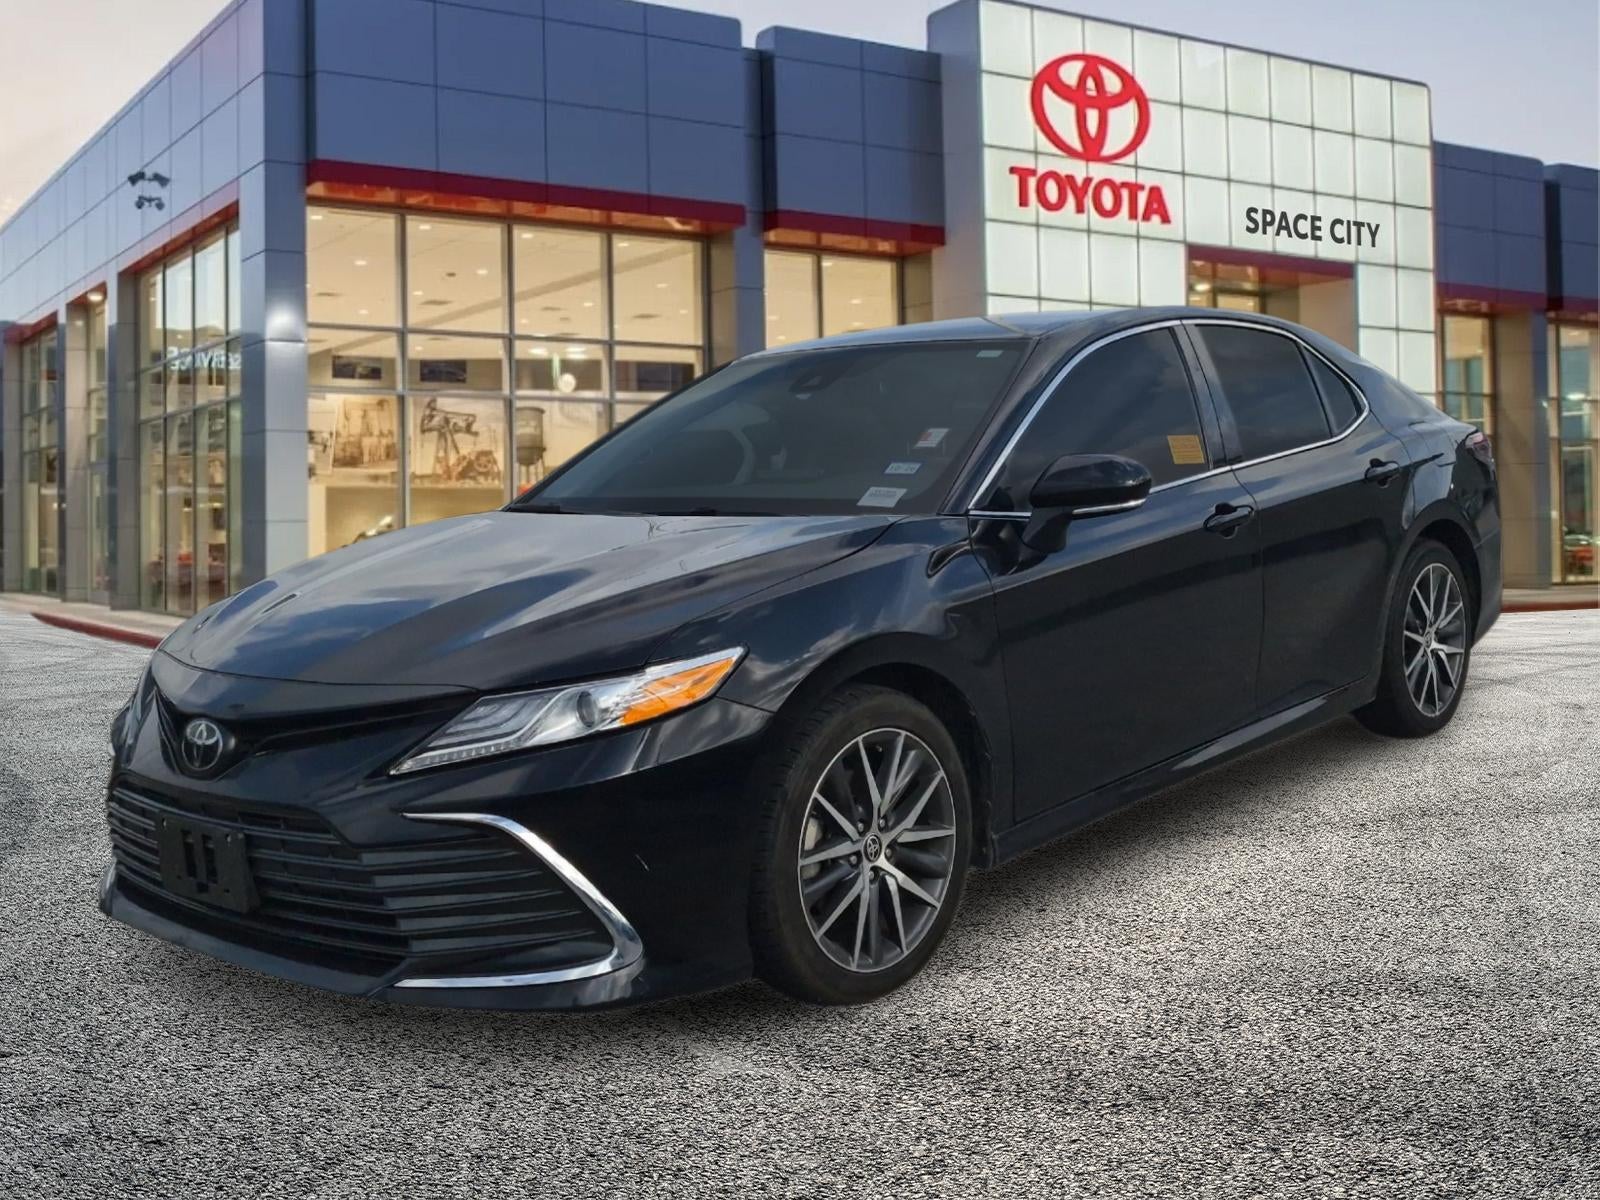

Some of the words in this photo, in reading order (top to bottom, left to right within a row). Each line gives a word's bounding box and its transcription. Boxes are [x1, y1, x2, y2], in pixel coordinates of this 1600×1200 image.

[1009, 166, 1171, 224] TOYOTA
[1245, 206, 1322, 241] SPACE
[1329, 217, 1380, 247] CITY
